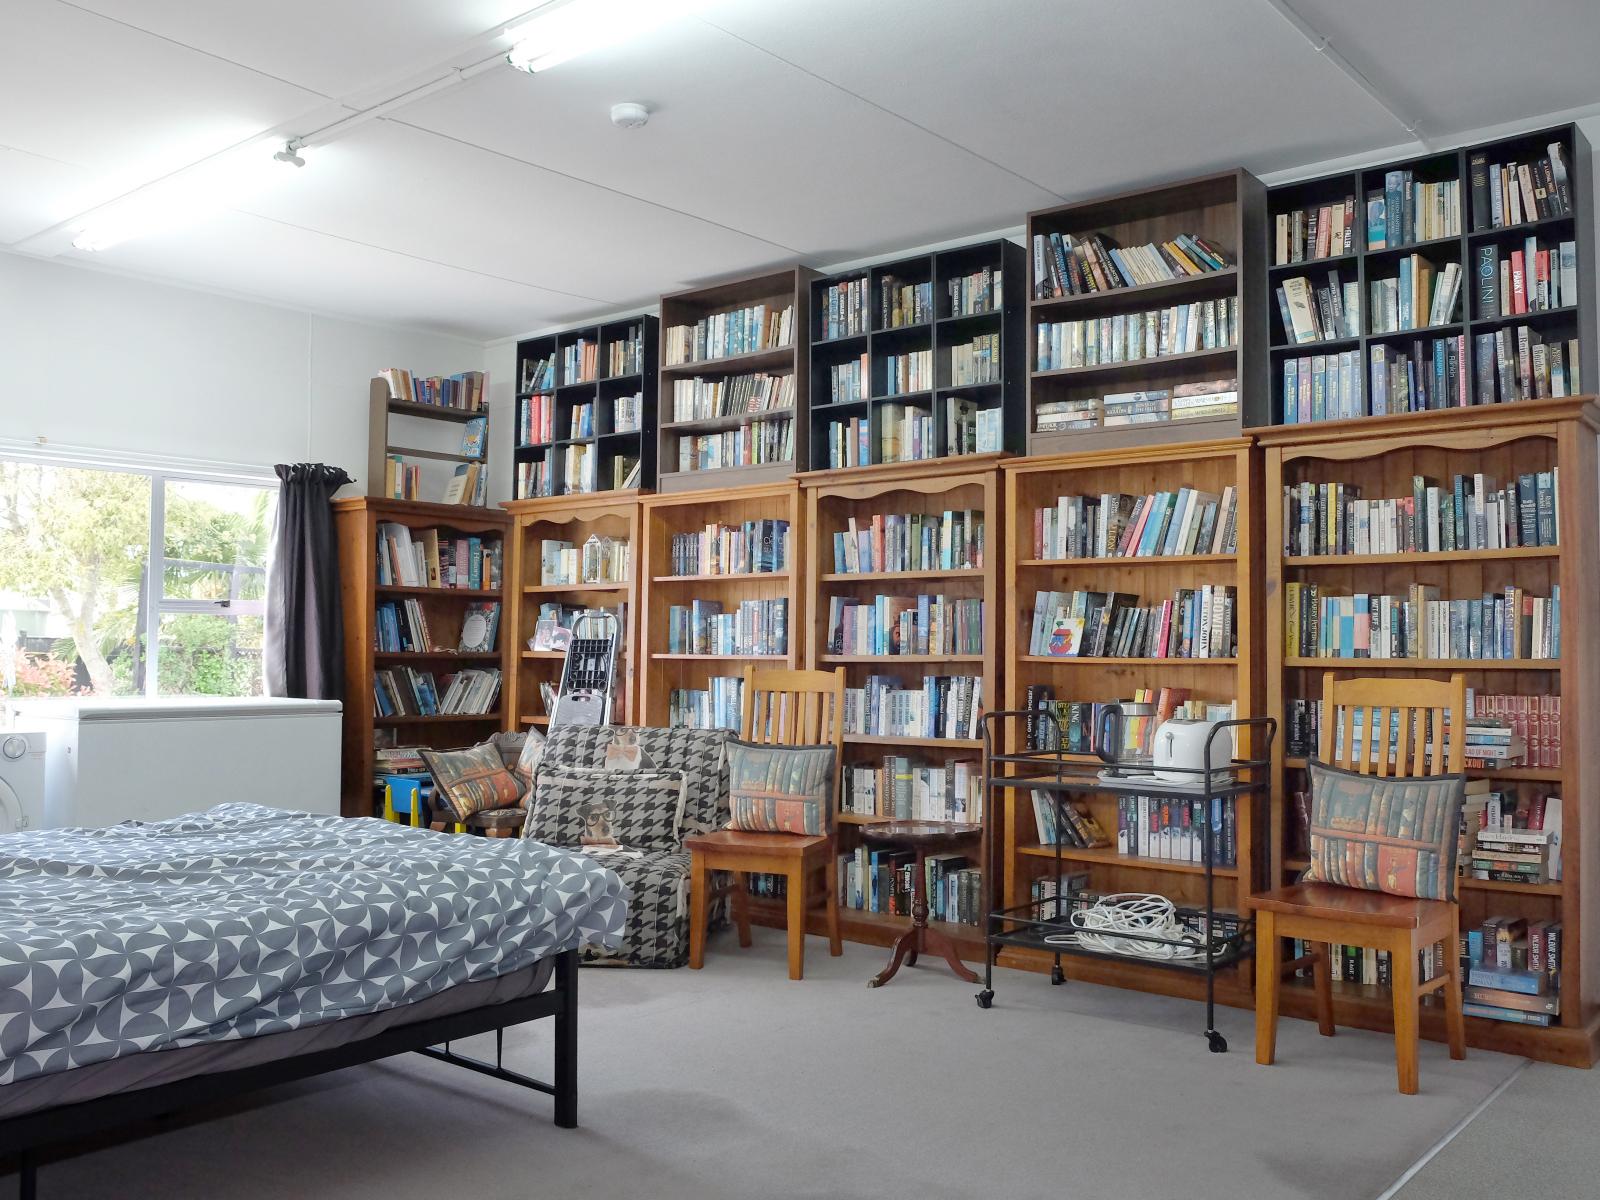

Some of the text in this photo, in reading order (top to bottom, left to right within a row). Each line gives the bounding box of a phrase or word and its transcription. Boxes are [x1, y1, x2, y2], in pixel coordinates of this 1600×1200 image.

[1480, 248, 1494, 303] PAOLINI
[1514, 270, 1523, 294] PARKY
[1534, 350, 1544, 372] Reichs
[1108, 530, 1116, 550] LION
[1505, 588, 1514, 618] JEEVES
[1212, 597, 1223, 636] BOWIE
[1465, 748, 1475, 757] EAD
[1548, 953, 1556, 970] SMITH
